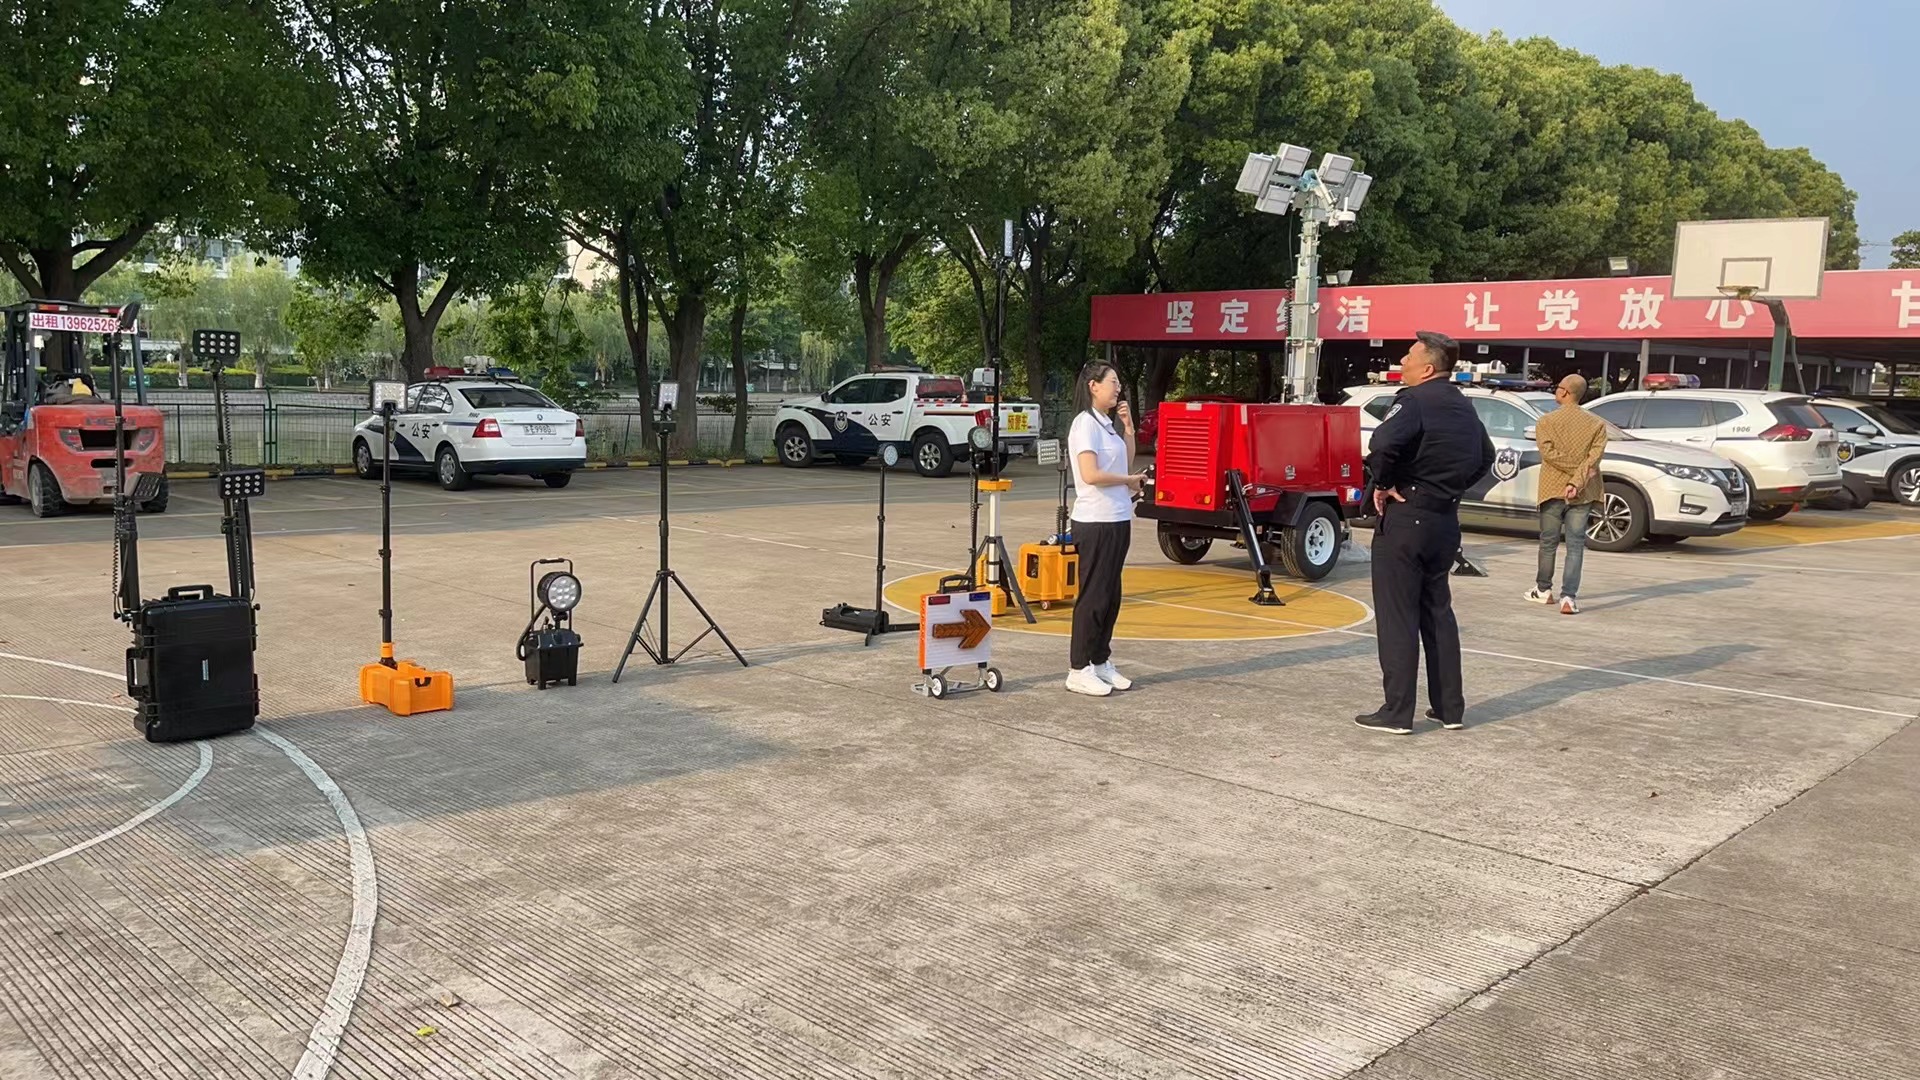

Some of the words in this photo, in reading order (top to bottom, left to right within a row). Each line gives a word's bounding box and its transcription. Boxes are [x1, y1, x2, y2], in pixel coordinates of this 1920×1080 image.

[1463, 287, 1755, 331] 让党放心
[32, 315, 59, 327] 出租
[61, 316, 136, 333] 139625269
[868, 413, 892, 426] 公安
[411, 421, 431, 439] 公安
